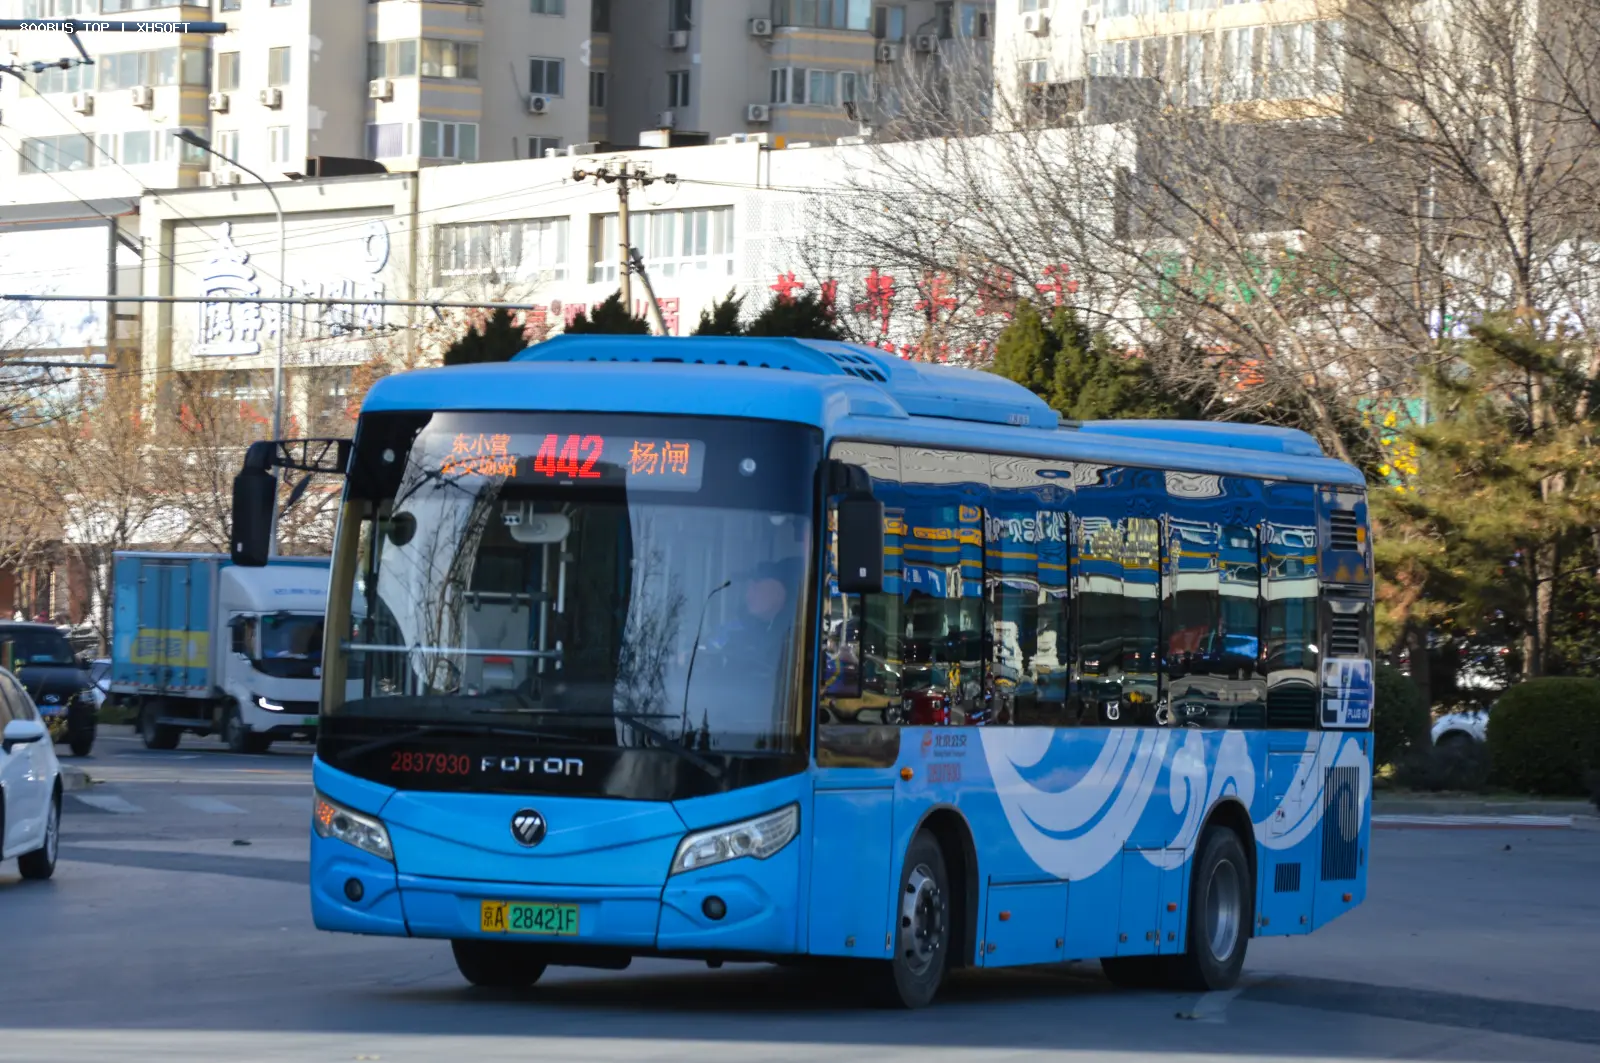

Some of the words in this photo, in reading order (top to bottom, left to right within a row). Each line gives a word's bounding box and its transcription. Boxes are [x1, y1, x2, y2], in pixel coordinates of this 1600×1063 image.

[451, 432, 511, 457] 东小营
[534, 434, 604, 478] 442
[627, 440, 690, 475] 杨闸
[391, 752, 470, 775] 2837930
[480, 755, 584, 777] FOTON
[512, 906, 577, 932] 28421F
